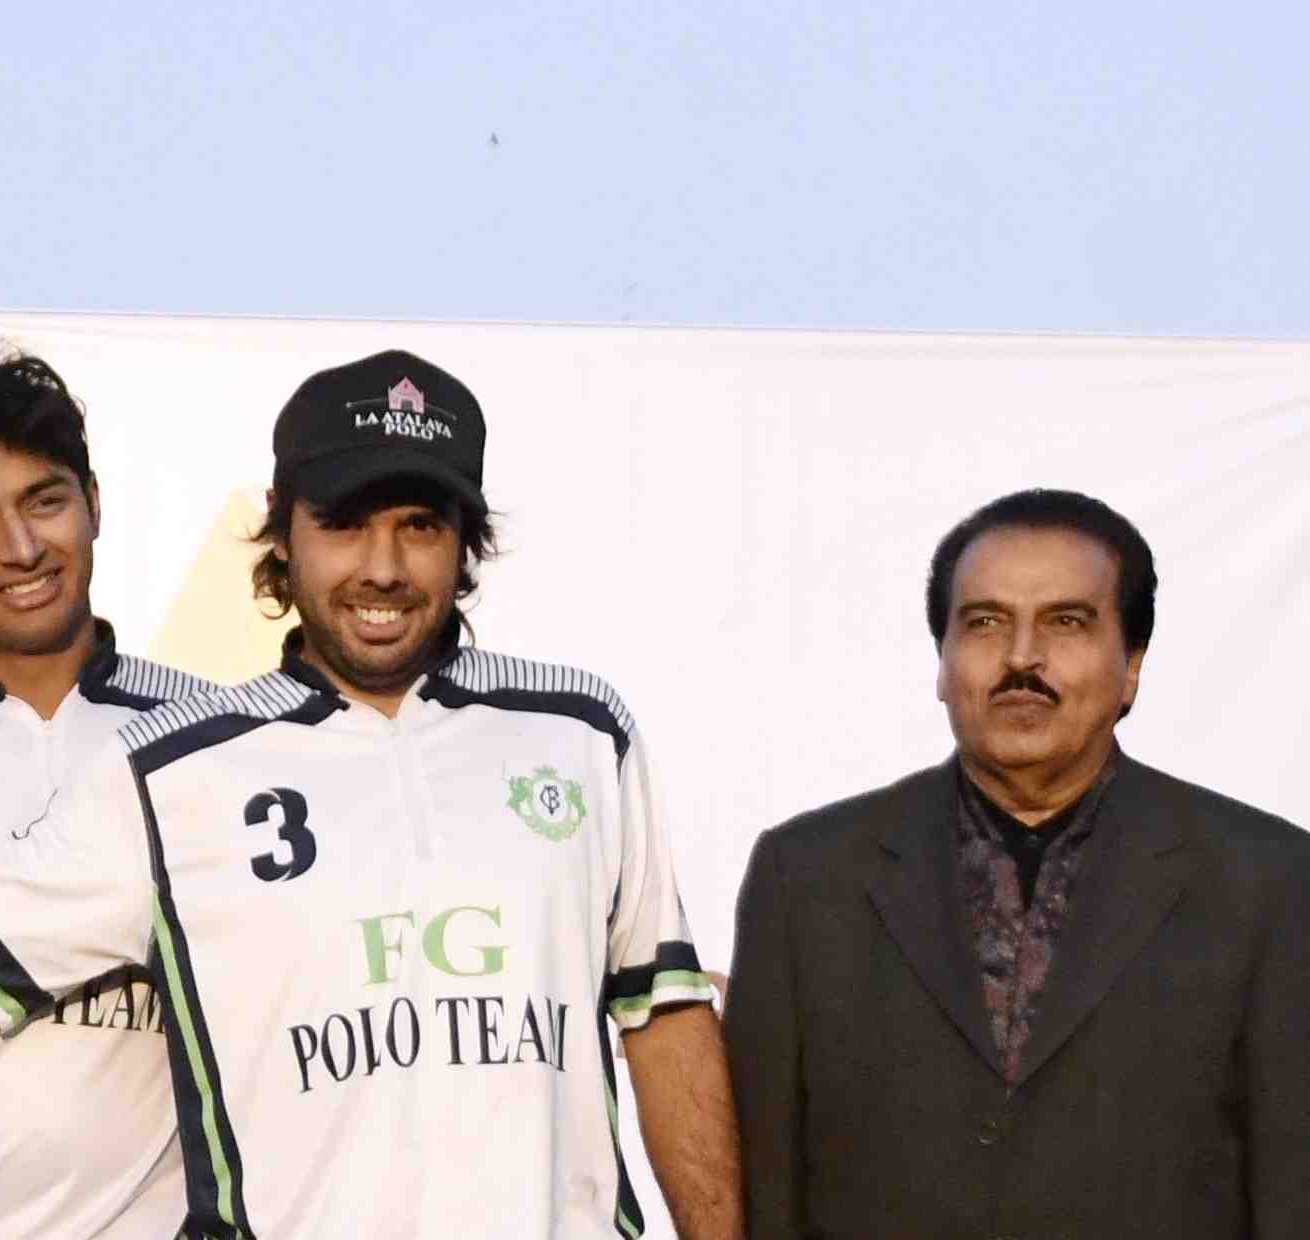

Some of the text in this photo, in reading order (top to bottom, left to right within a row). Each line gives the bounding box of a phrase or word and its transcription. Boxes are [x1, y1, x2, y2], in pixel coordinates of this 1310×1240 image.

[354, 410, 453, 440] LA ATALAYA
[384, 421, 434, 441] POLO
[243, 786, 318, 883] 3
[353, 905, 509, 987] FG
[287, 994, 569, 1094] POLO TEAM
